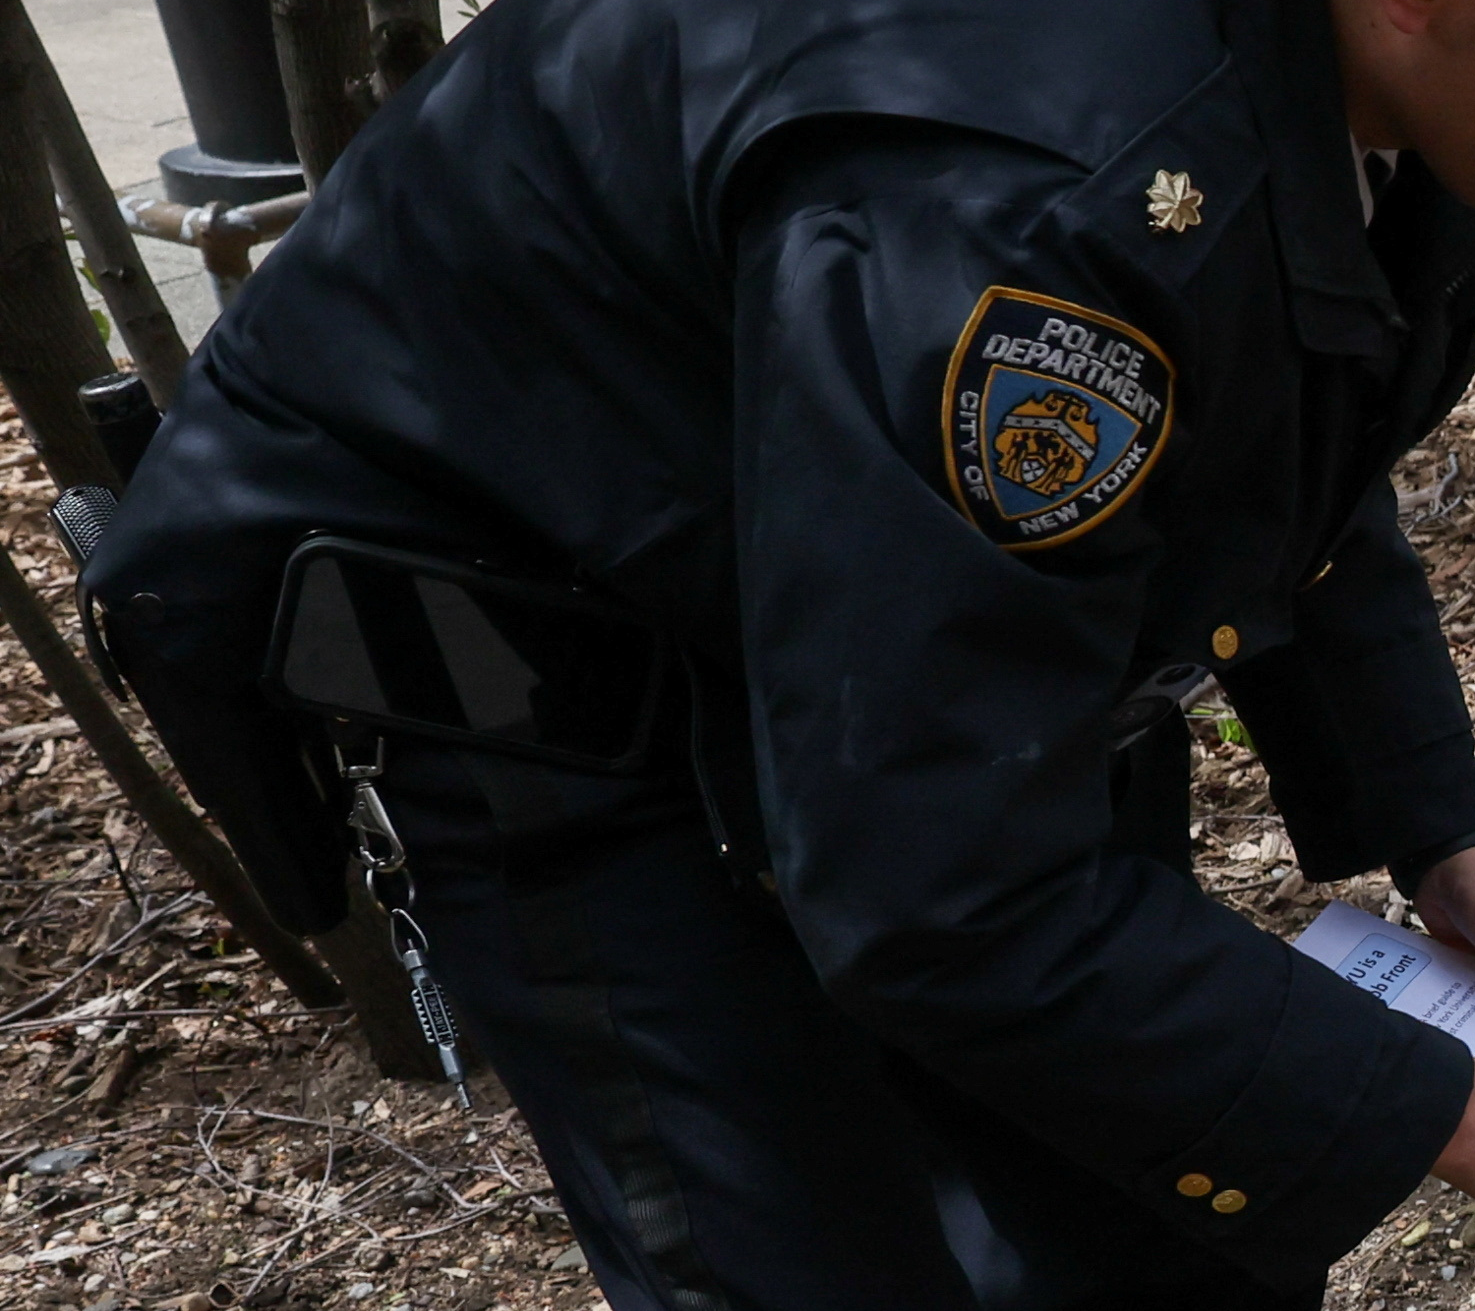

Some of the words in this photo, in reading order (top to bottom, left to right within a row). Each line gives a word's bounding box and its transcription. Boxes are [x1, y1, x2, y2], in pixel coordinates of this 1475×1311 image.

[982, 334, 1162, 424] DEPARTMENT
[1037, 317, 1145, 379] POLICE
[959, 391, 979, 456] CITY
[964, 465, 990, 501] OF
[1019, 501, 1080, 535] NEW
[1082, 441, 1148, 504] YORK
[1362, 956, 1376, 970] is
[1372, 949, 1385, 959] a
[1381, 953, 1417, 983] Front
